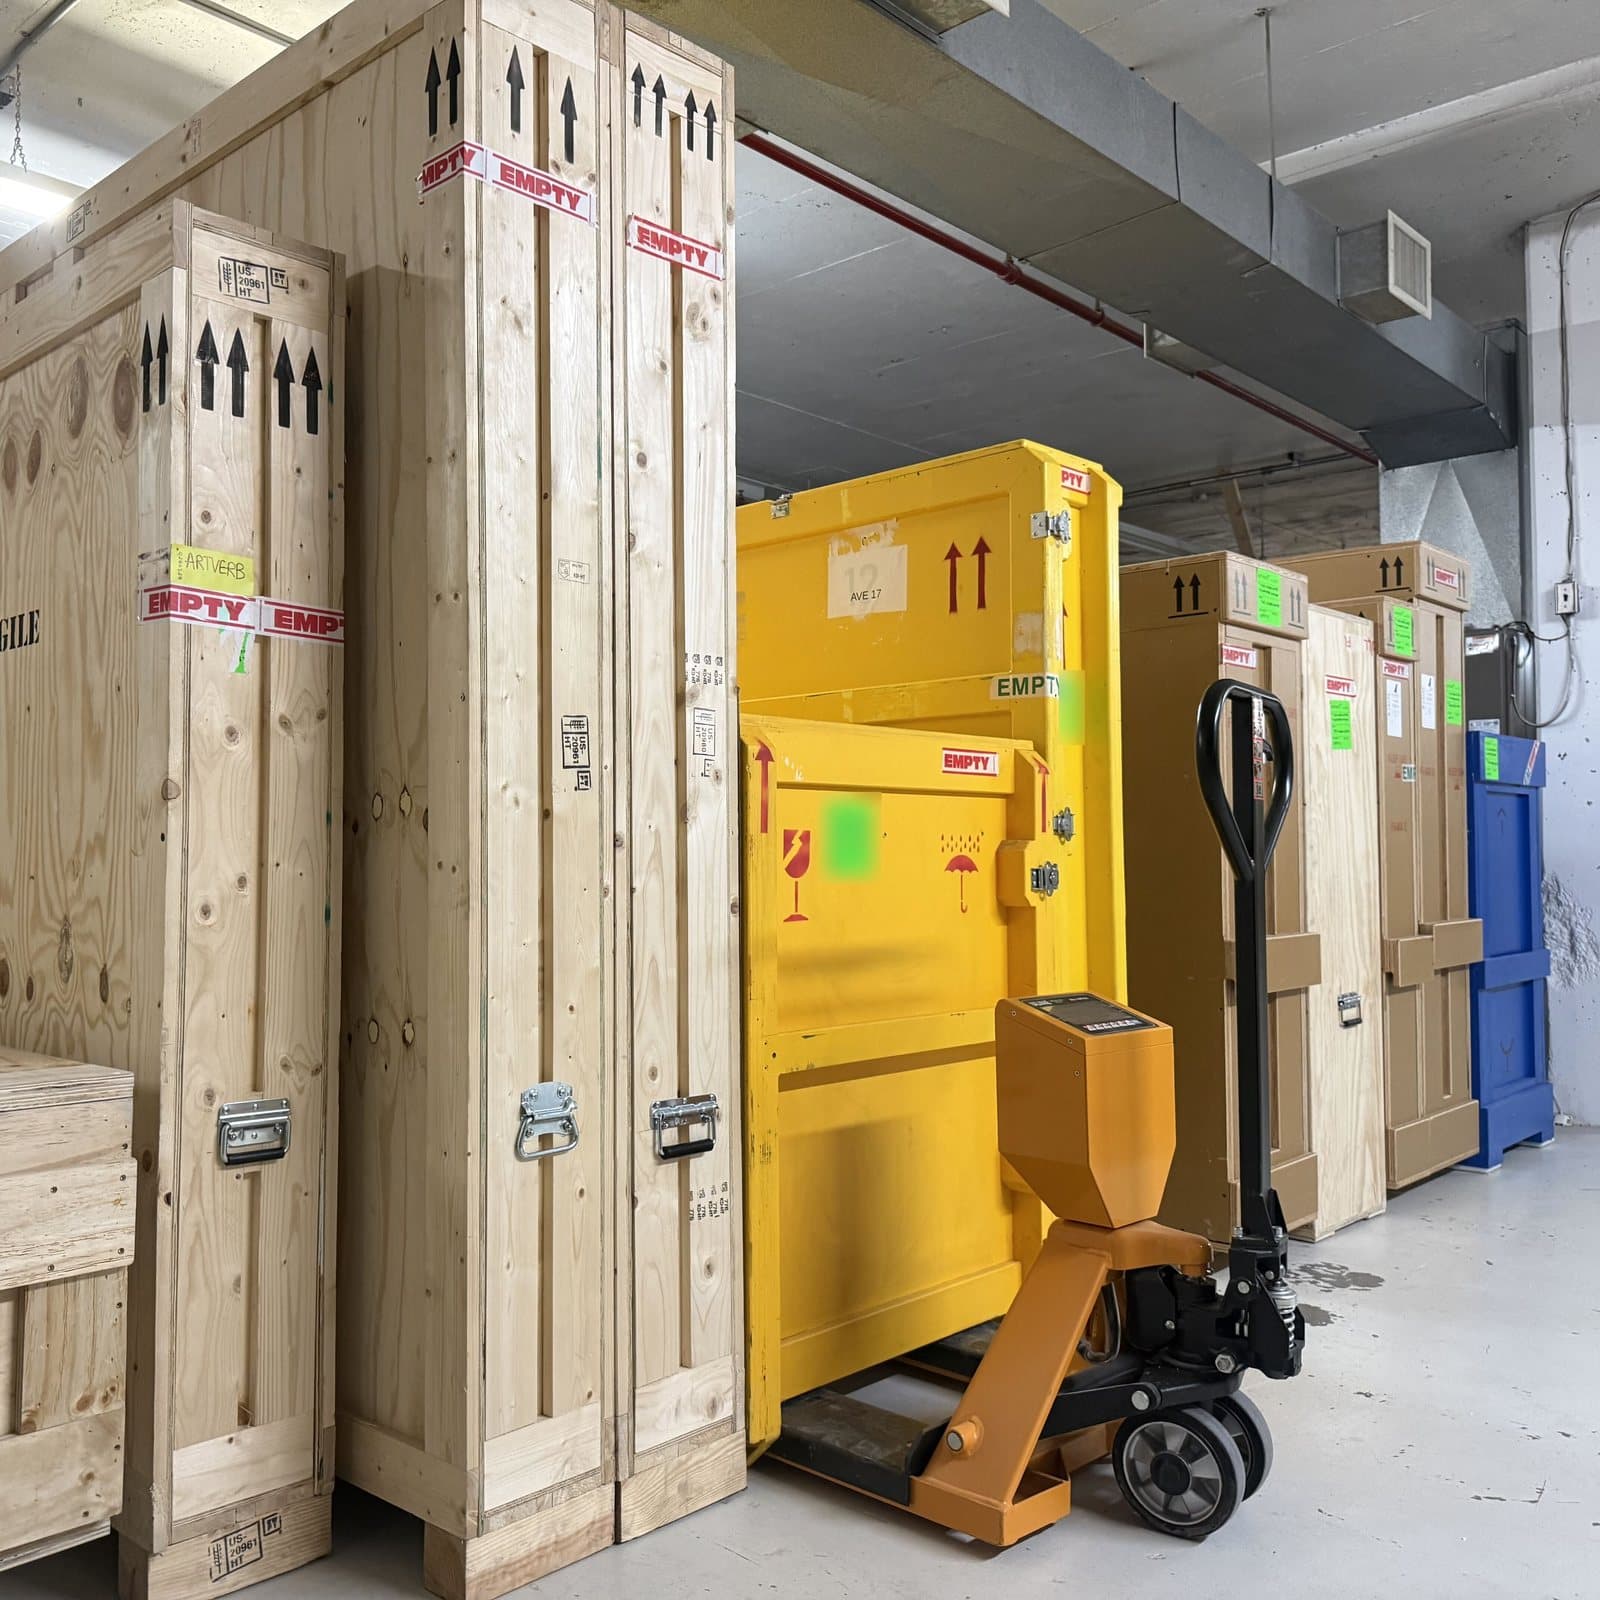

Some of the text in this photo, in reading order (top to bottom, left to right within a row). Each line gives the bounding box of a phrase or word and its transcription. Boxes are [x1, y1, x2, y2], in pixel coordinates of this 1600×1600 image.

[500, 163, 581, 211] EMPTY
[637, 225, 708, 267] EMPTY
[239, 276, 265, 290] 20961
[239, 287, 252, 297] HT
[1061, 470, 1082, 488] PTY
[184, 552, 246, 580] ARTVERB
[851, 589, 882, 601] AVE 17
[148, 590, 344, 636] EMPTY EMP
[564, 736, 571, 749] HT
[944, 753, 989, 771] EMPTY
[229, 1538, 257, 1557] 20961
[230, 1554, 244, 1569] HT
